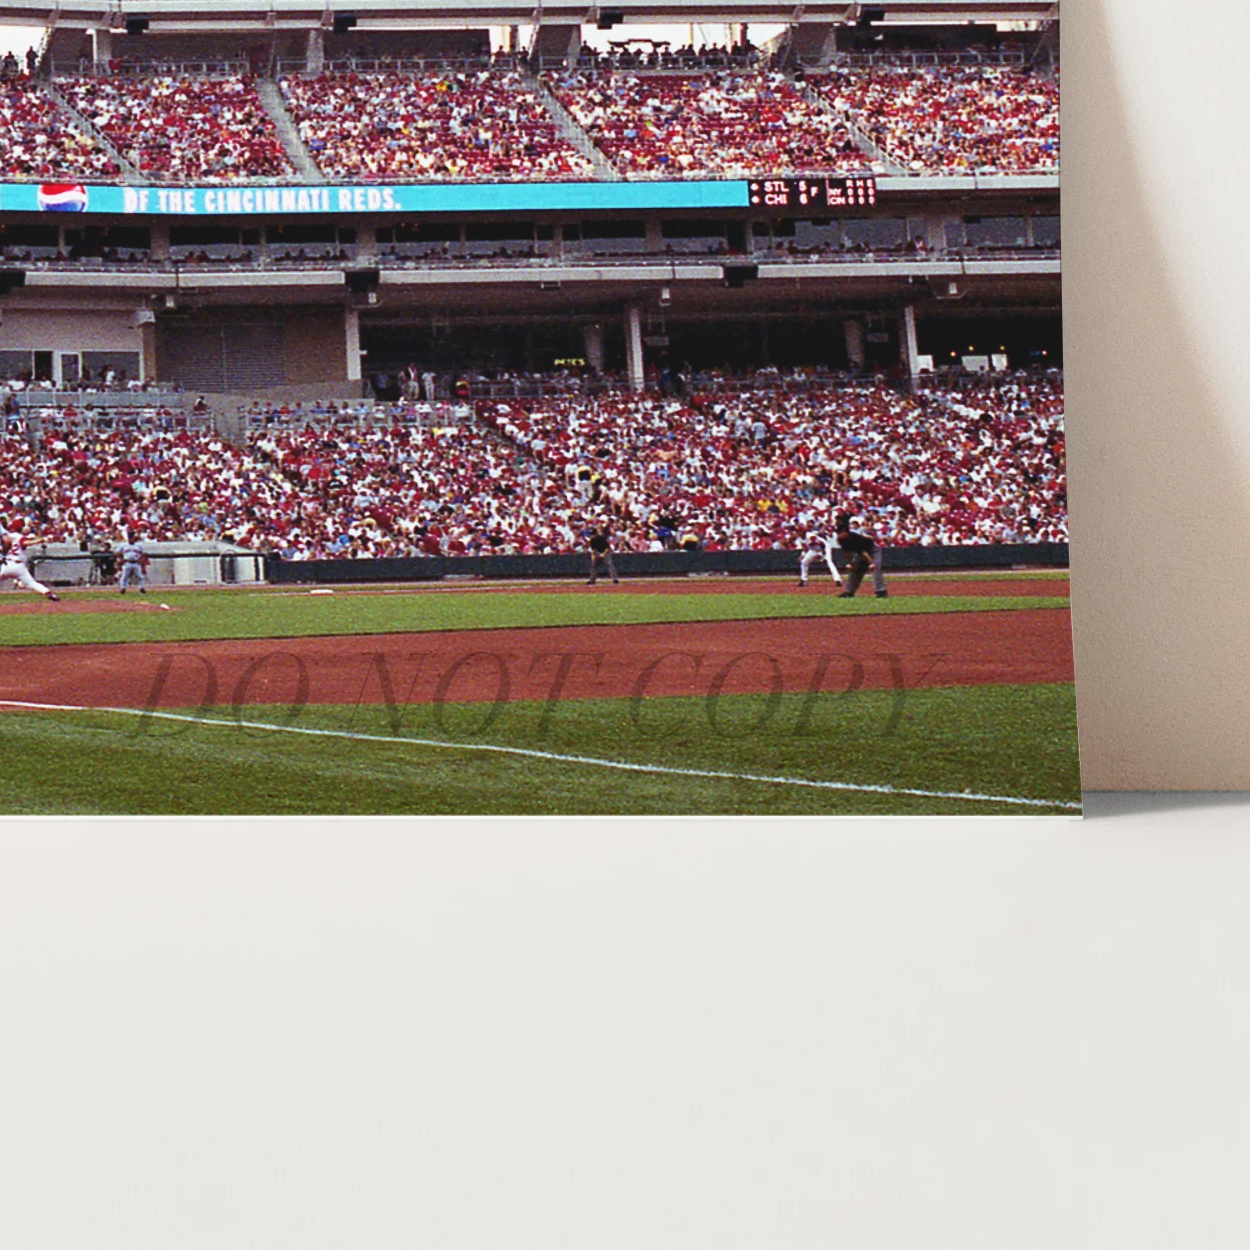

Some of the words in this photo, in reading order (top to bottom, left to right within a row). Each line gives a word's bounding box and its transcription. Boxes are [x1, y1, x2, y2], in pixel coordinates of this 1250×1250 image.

[764, 181, 789, 192] STL
[158, 190, 196, 213] THE
[204, 189, 329, 213] CINCINNATI
[338, 188, 402, 212] REDS.
[764, 194, 788, 205] CHI
